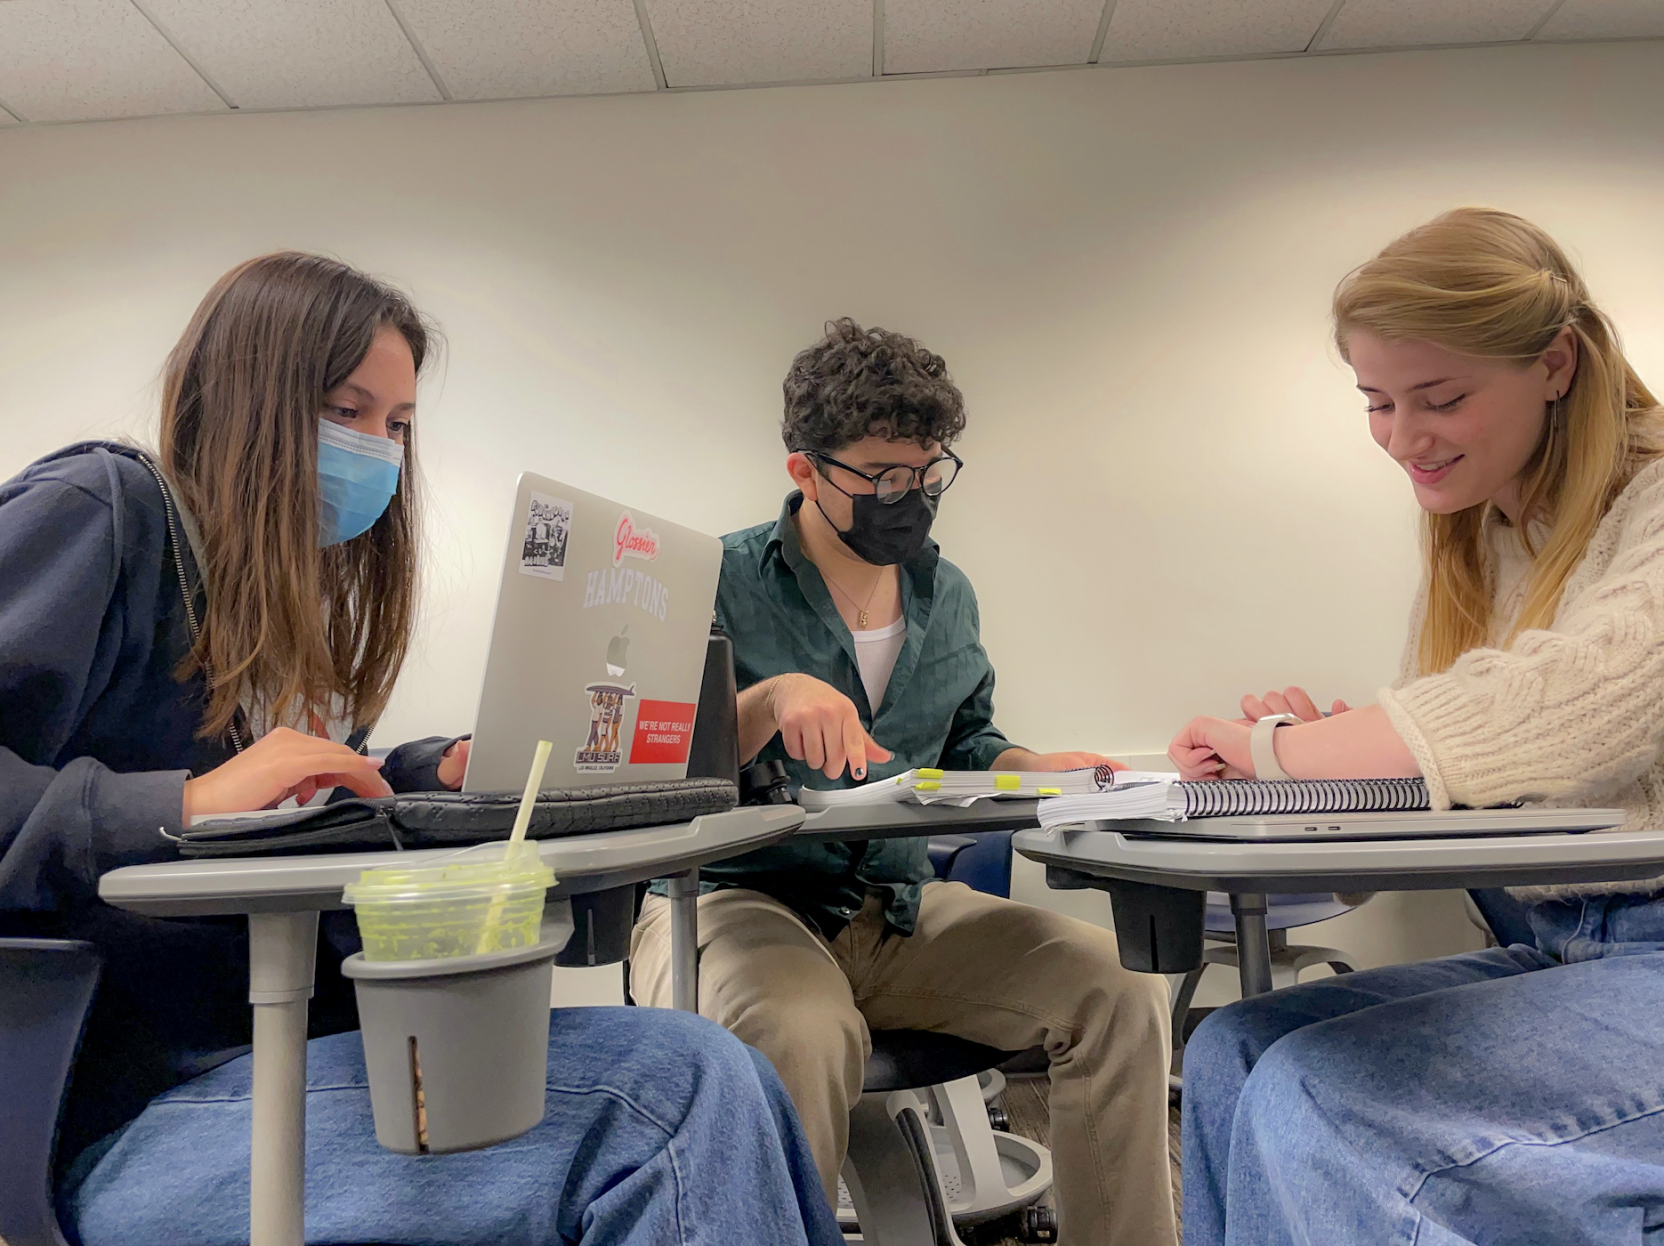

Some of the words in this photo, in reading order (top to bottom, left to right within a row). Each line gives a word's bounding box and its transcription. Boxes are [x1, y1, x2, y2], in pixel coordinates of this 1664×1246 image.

[616, 518, 658, 561] Glossier
[583, 568, 668, 622] HAMPTONS
[639, 720, 658, 731] WE'RE
[659, 721, 671, 732] NOT
[671, 722, 691, 732] REALLY
[646, 733, 681, 744] STRANGERS
[576, 752, 596, 763] LMU
[597, 753, 620, 763] SURF
